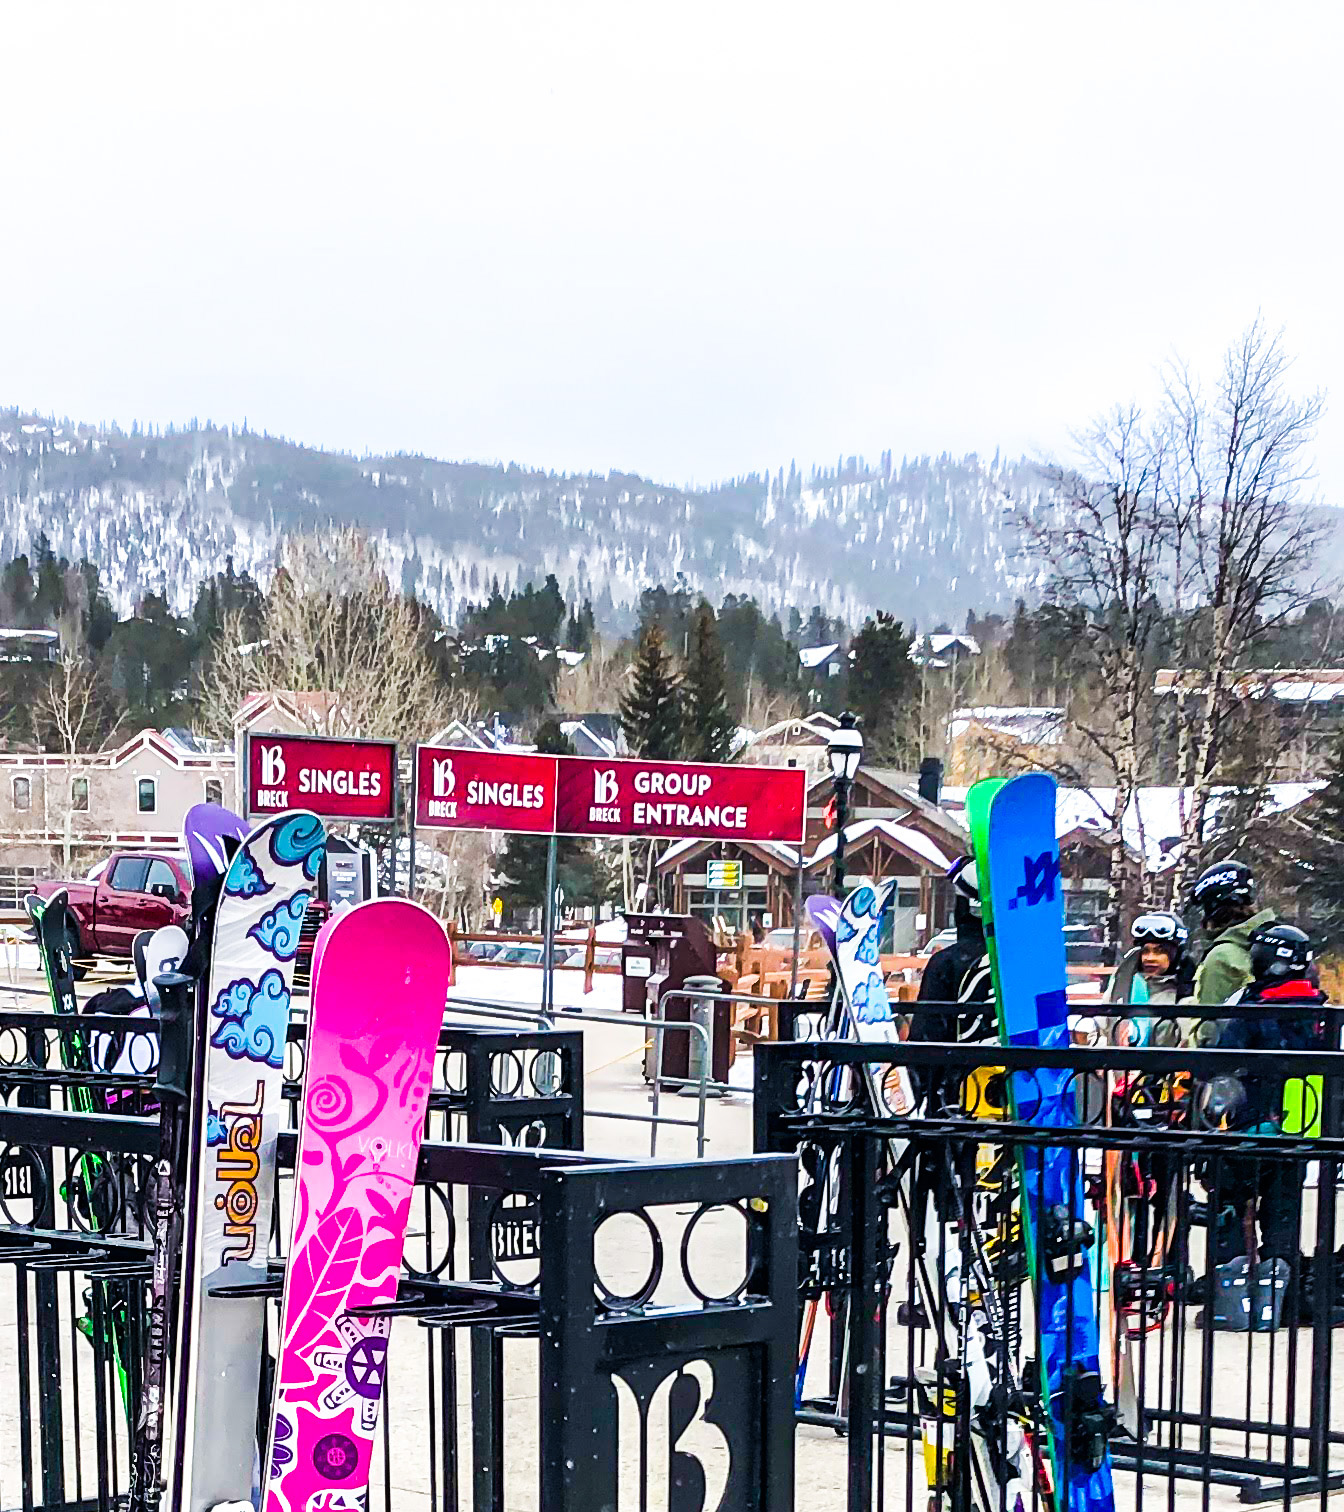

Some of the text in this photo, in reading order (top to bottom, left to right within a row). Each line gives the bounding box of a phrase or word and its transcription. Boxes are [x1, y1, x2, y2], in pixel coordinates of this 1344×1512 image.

[298, 768, 381, 797] SINGLES
[466, 780, 544, 809] SINGLES
[633, 771, 712, 796] GROUP
[257, 789, 289, 808] BRECK
[428, 800, 457, 819] BRECK
[589, 807, 621, 823] BRECK
[633, 802, 748, 828] ENTRANCE
